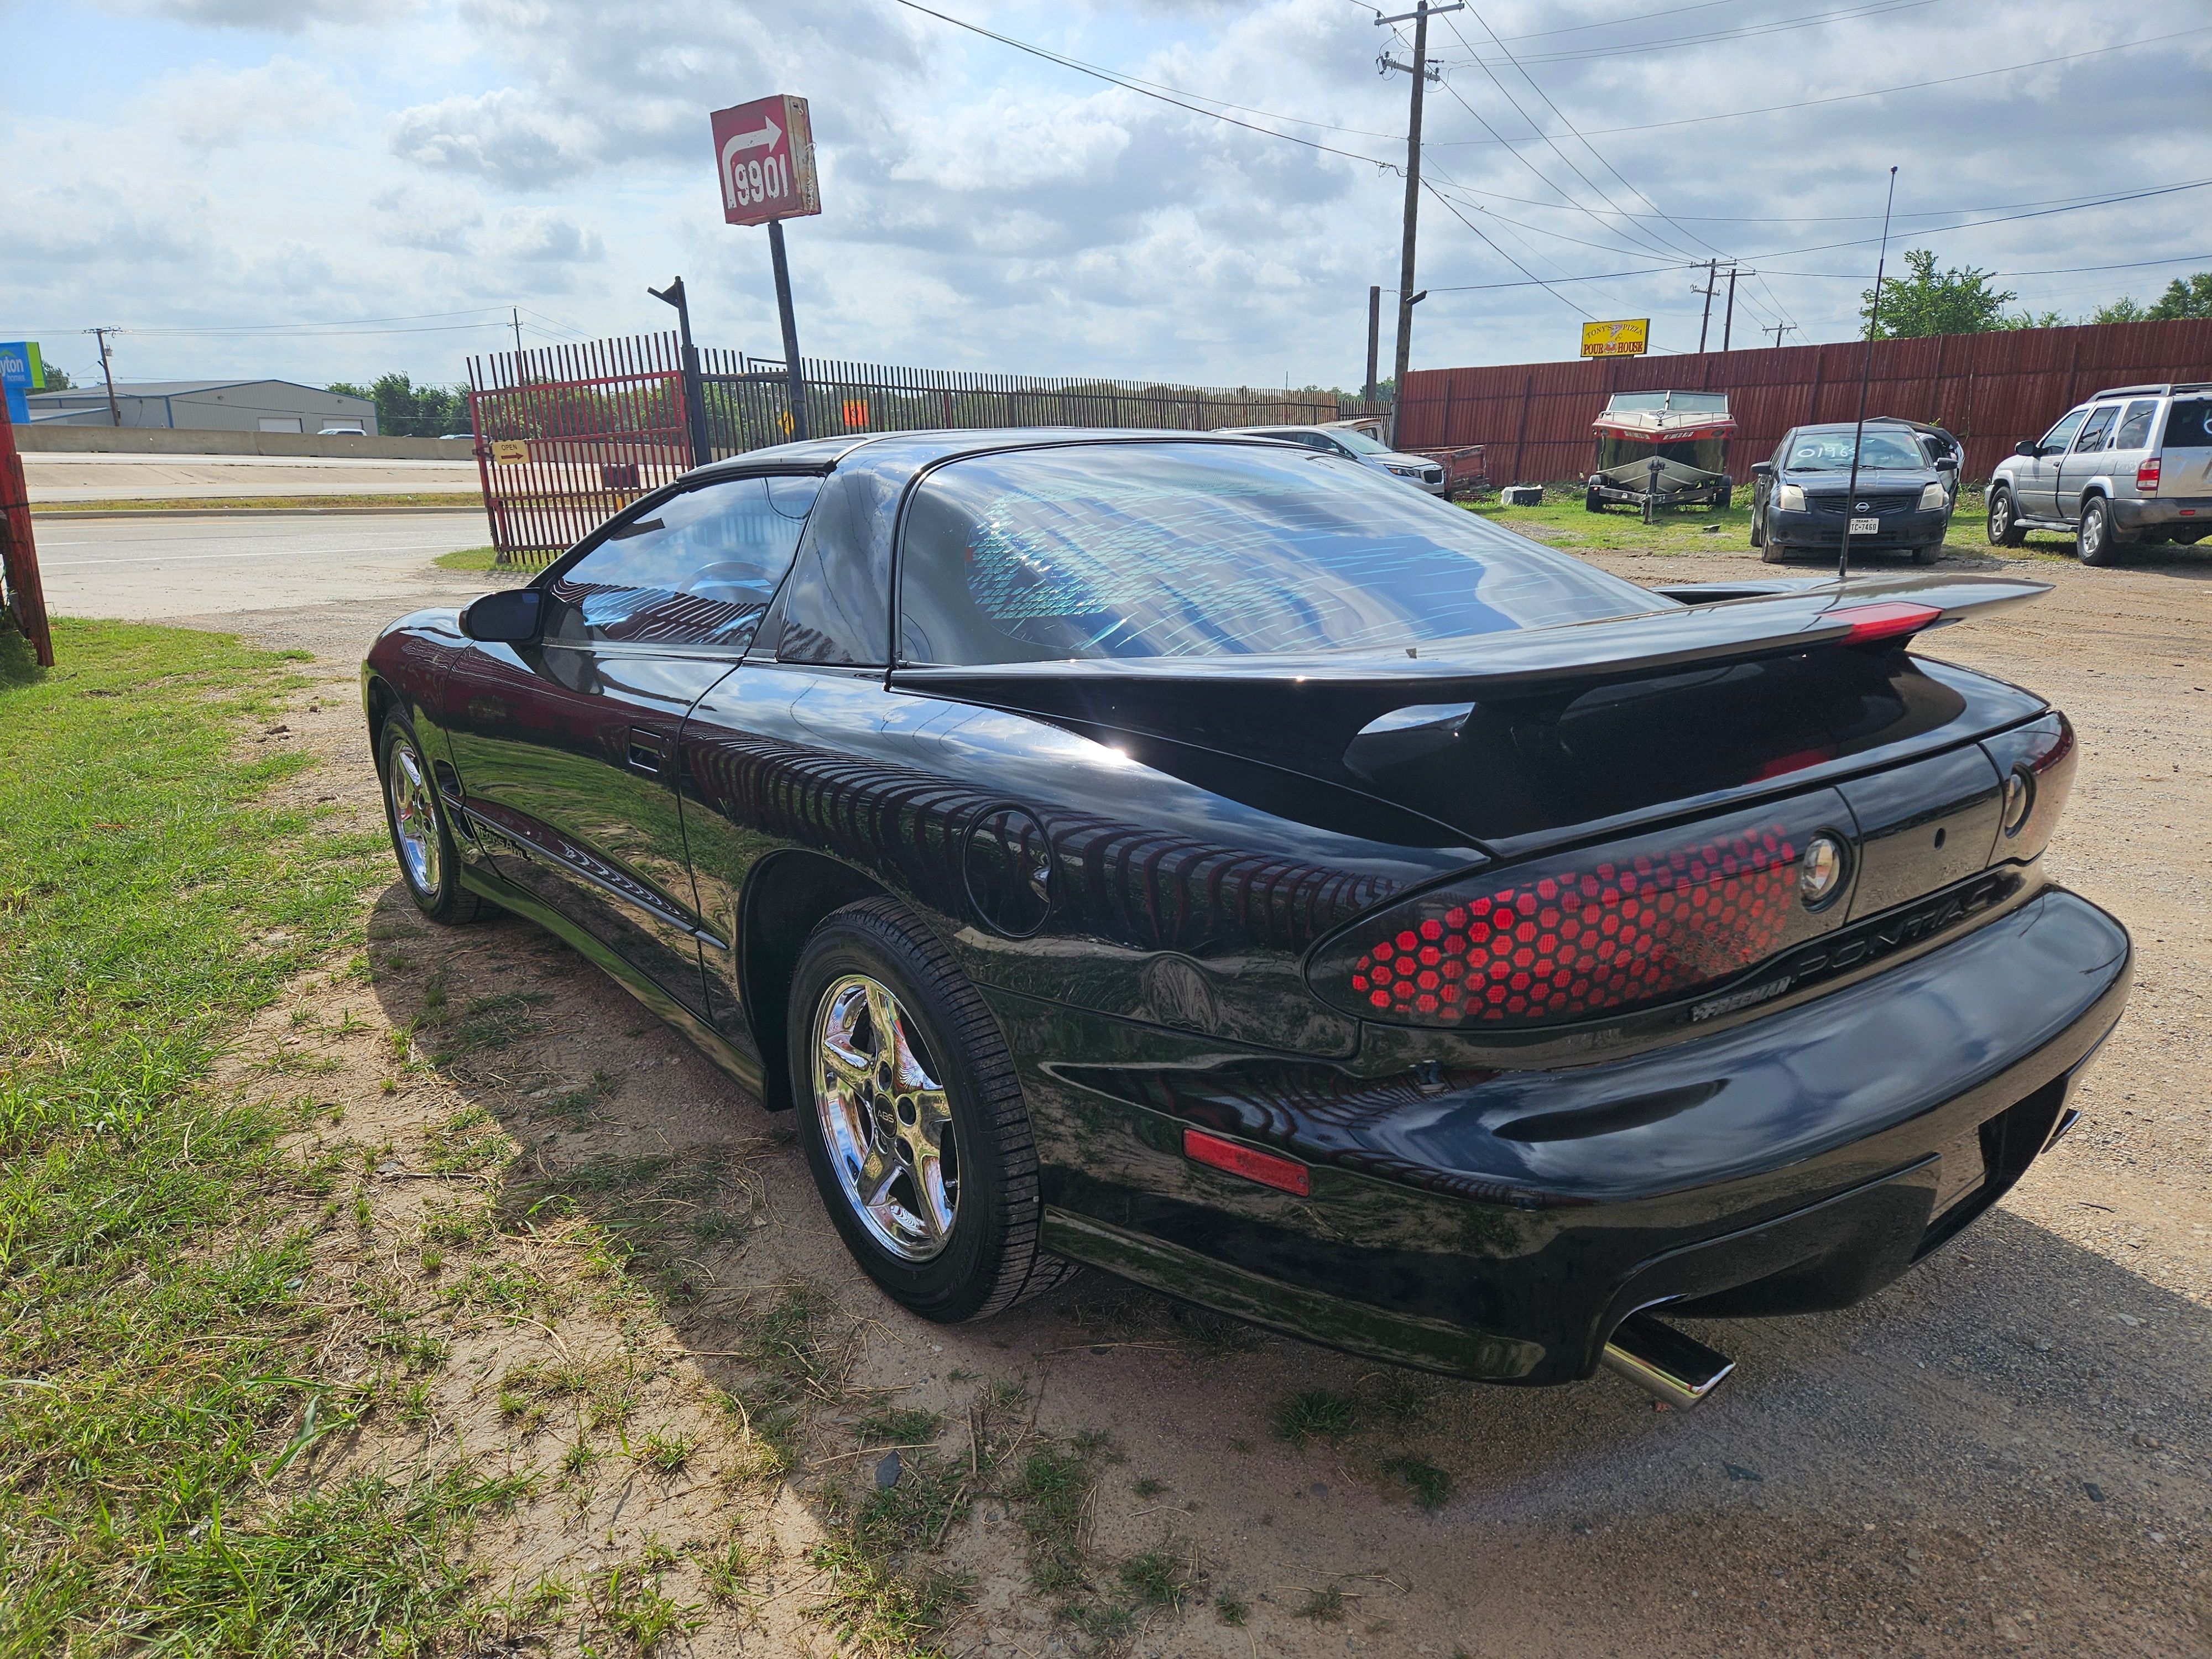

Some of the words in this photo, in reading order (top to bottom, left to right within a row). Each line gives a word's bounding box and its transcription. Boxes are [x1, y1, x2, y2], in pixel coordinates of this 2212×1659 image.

[734, 154, 789, 206] 9901
[1586, 325, 1612, 338] TONY'S
[1623, 324, 1642, 336] PIZZA
[1615, 333, 1623, 341] &
[1583, 343, 1604, 354] POUR
[1618, 341, 1643, 353] HOUSE
[0, 356, 24, 377] yton
[1791, 881, 1996, 984] PONTIAC
[877, 1109, 895, 1123] ABS
